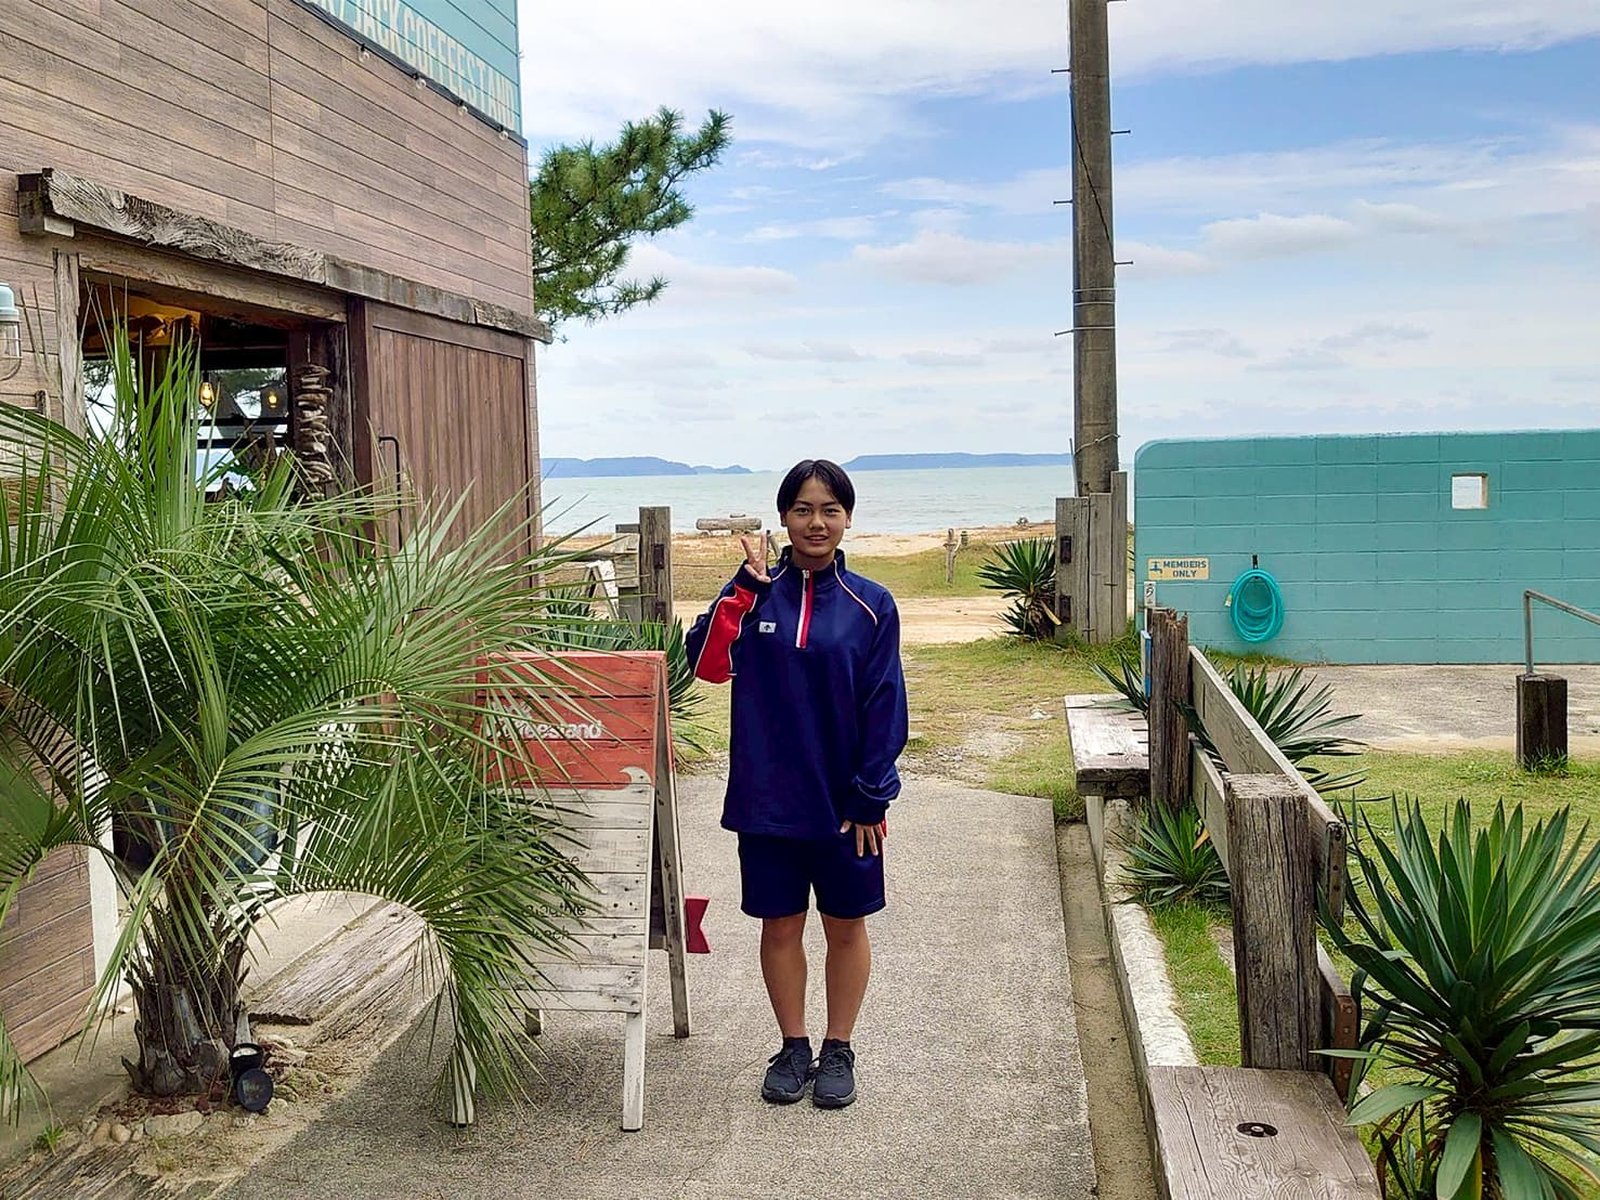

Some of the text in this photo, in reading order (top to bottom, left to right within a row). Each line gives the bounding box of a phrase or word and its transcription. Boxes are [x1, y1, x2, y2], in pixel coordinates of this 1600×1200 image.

[354, 0, 402, 59] JACK
[1163, 560, 1207, 569] MEMBERS
[1172, 569, 1197, 578] ONLY
